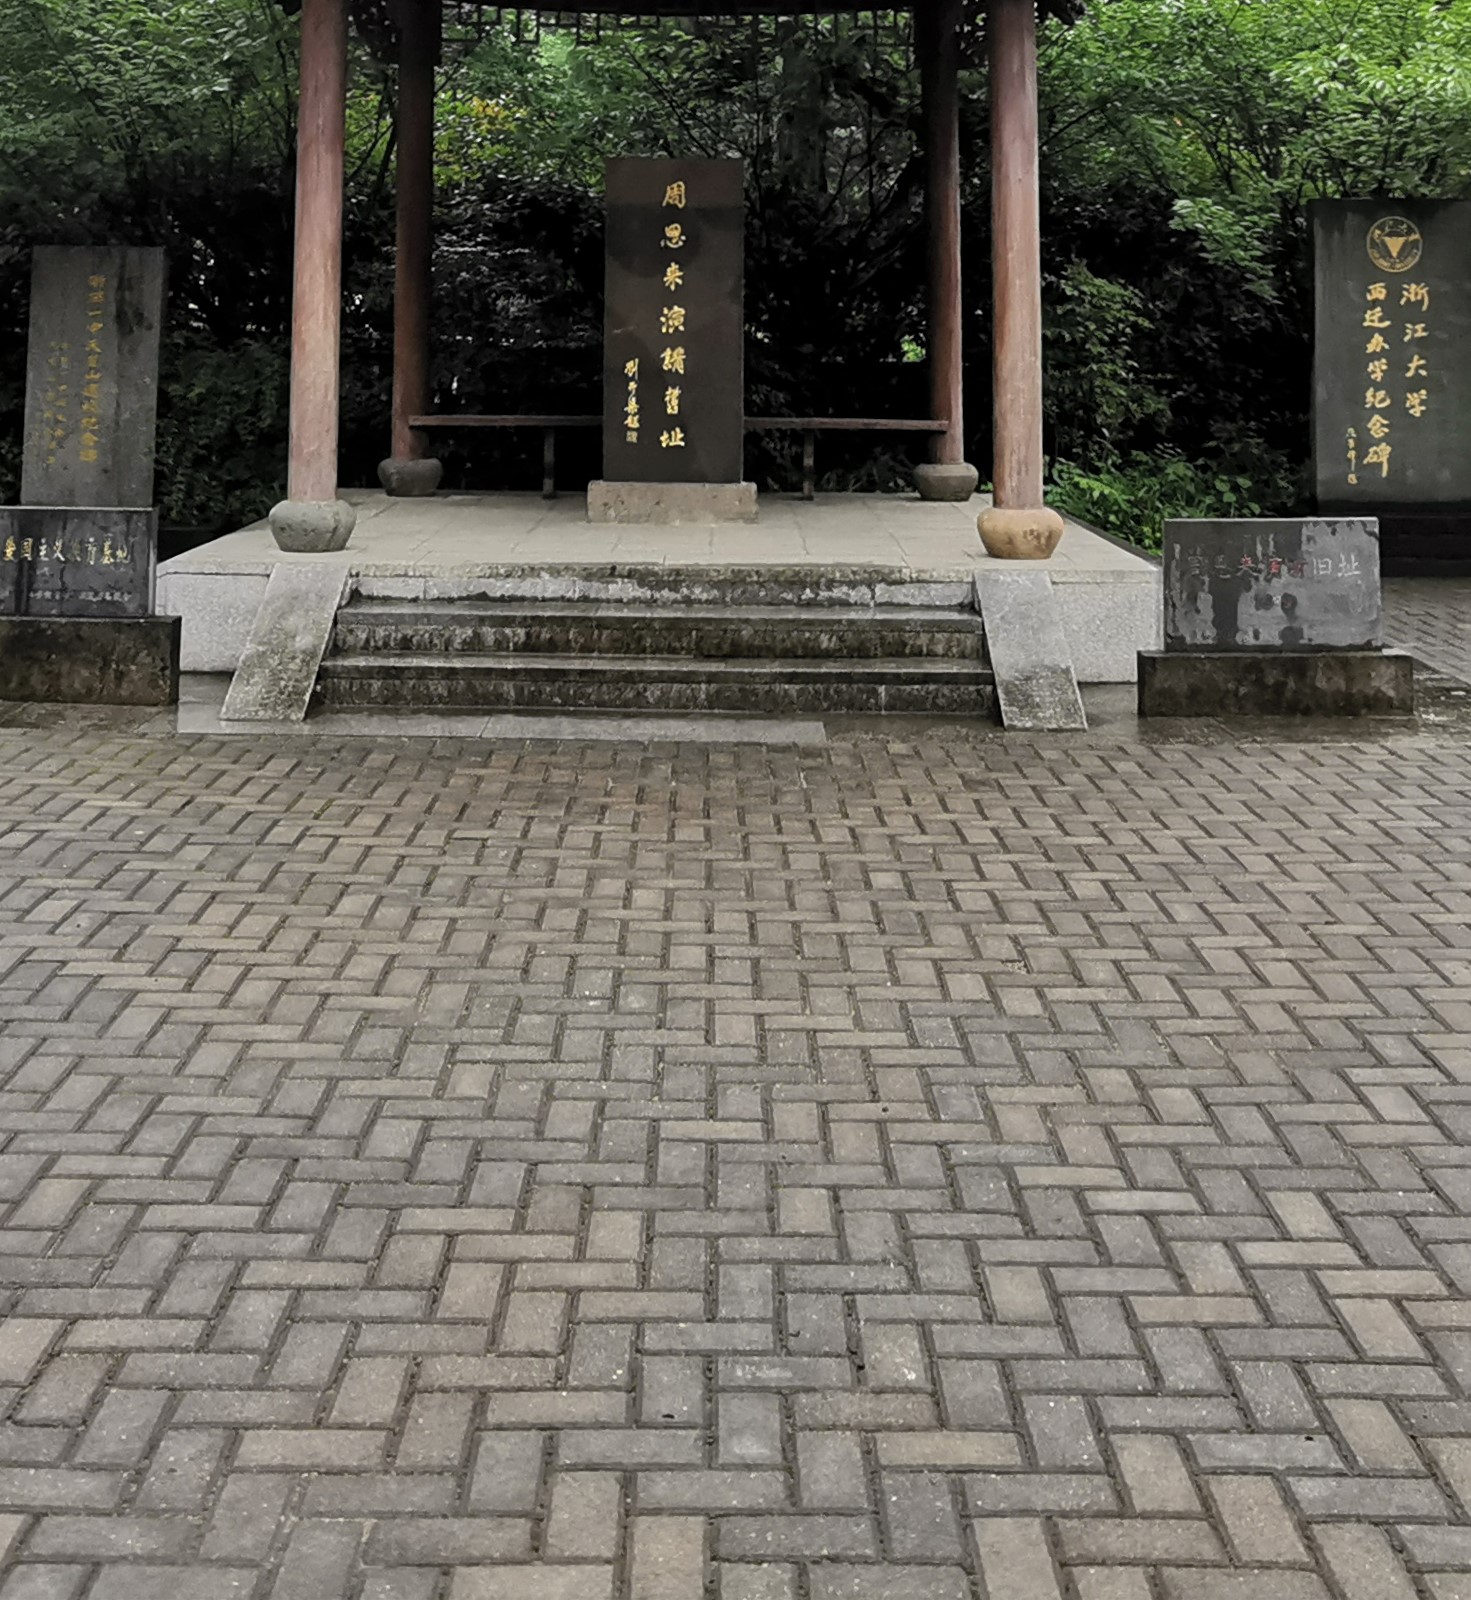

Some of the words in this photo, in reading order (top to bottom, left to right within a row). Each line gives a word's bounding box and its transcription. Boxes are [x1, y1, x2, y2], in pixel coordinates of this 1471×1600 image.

[1362, 282, 1392, 478] 西迁办学纪念碑
[1399, 282, 1430, 418] 浙江大学
